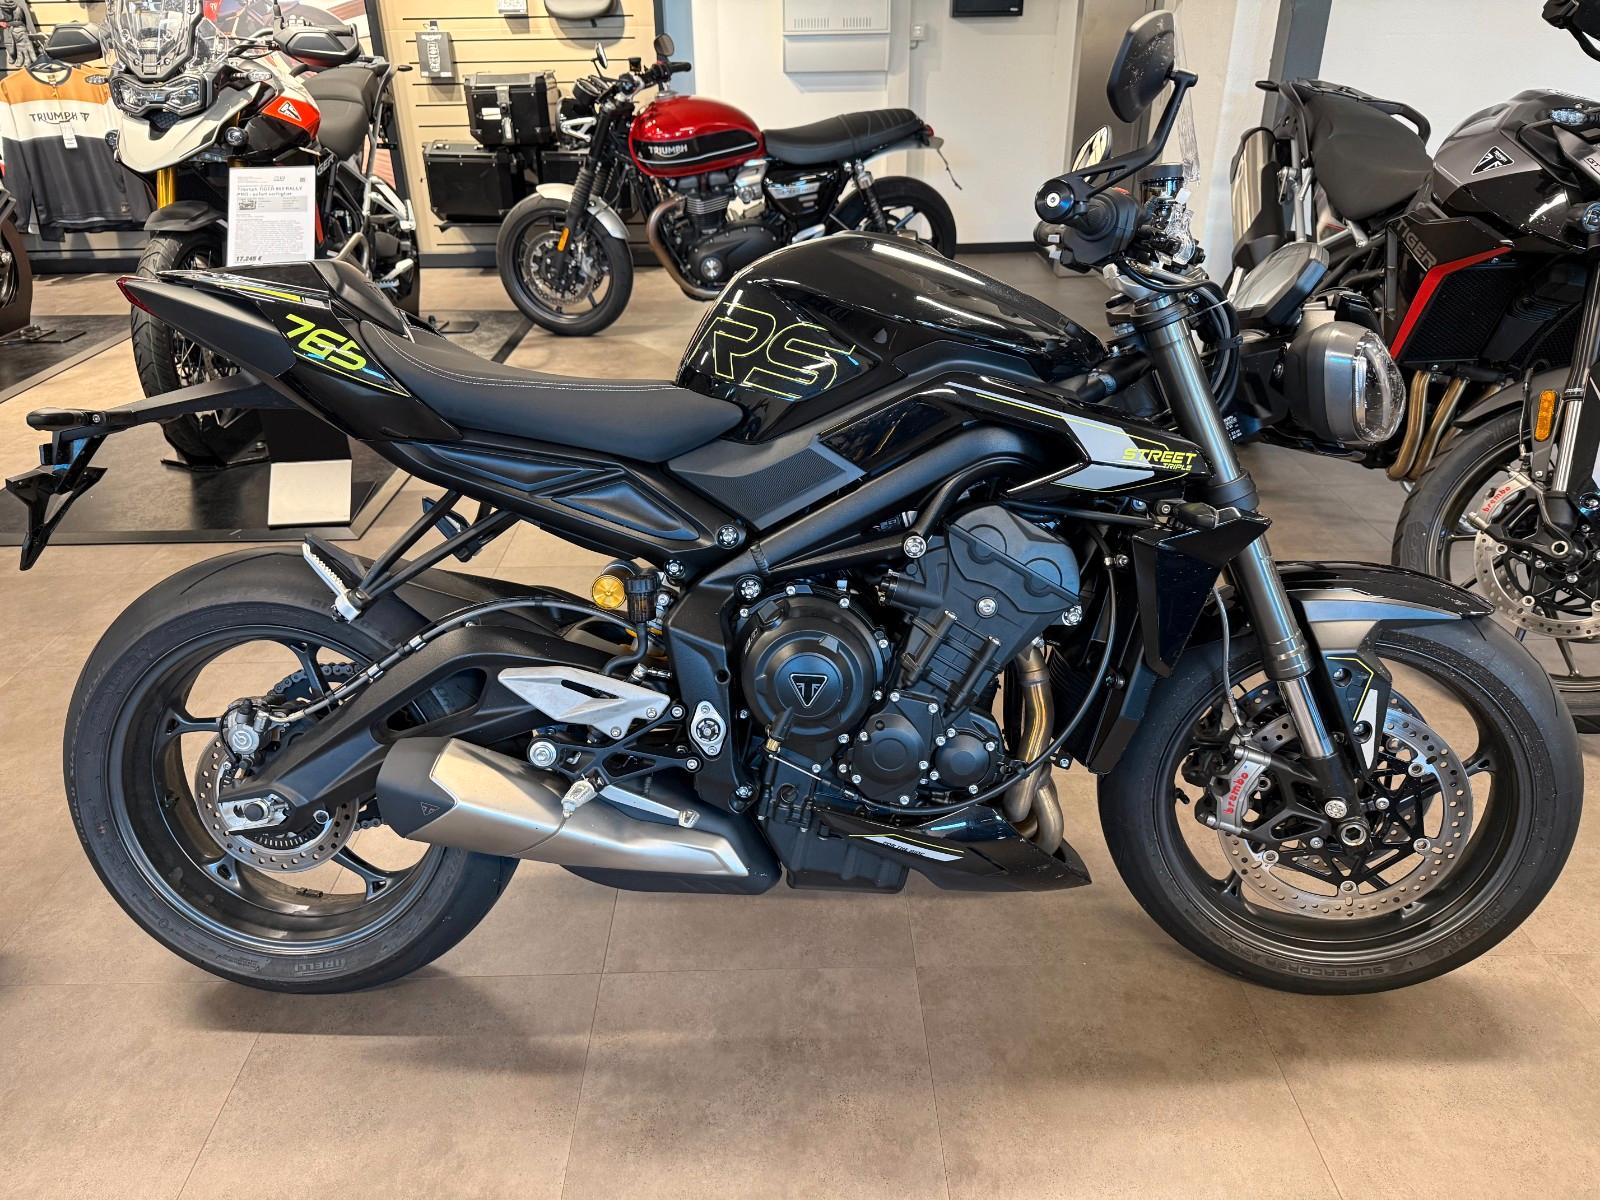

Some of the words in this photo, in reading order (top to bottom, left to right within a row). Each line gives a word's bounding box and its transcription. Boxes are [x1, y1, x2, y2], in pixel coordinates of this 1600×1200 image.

[29, 112, 78, 122] TRIUMPH
[648, 144, 688, 154] TRIUMPH
[1397, 218, 1438, 269] TIGER
[286, 313, 367, 371] 765
[686, 301, 856, 399] RS
[1122, 447, 1197, 465] STREET
[1163, 463, 1192, 471] TRIPLE
[1482, 486, 1511, 513] brembo
[1223, 772, 1249, 814] brembo
